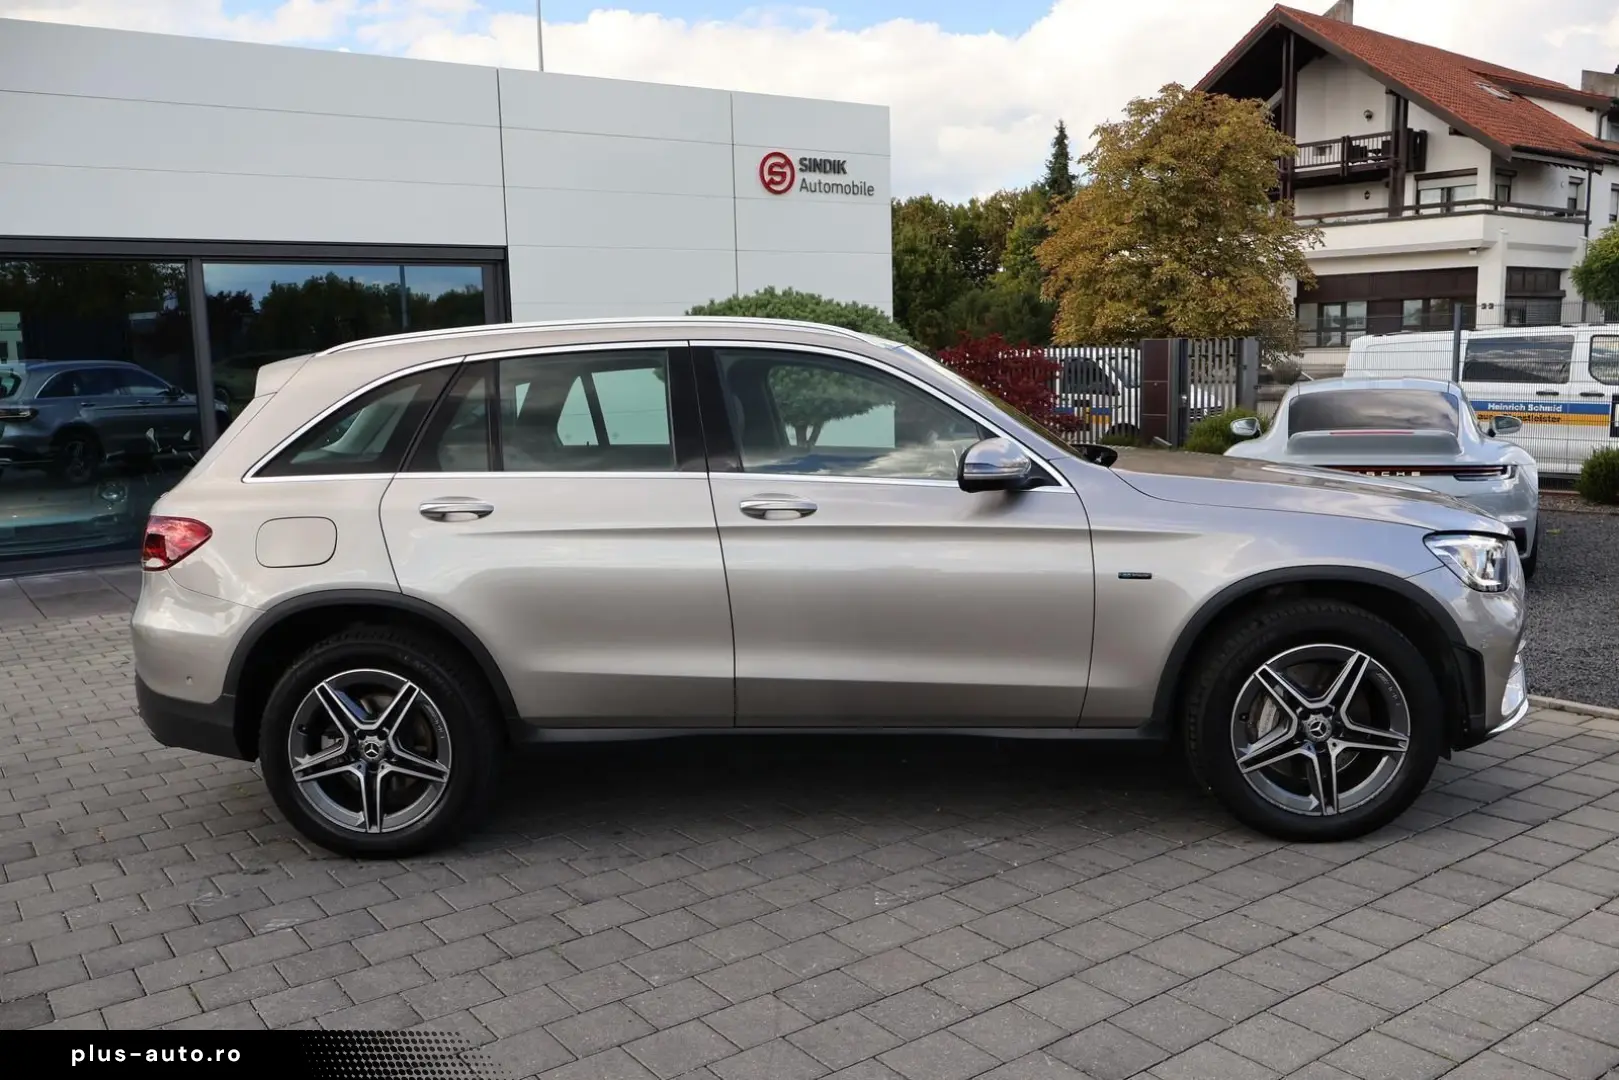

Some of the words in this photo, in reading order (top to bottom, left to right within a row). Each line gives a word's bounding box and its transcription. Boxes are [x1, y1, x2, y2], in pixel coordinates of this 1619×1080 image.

[799, 157, 848, 175] SINDIK
[799, 178, 875, 196] Automobile
[1488, 402, 1526, 412] Heinrich
[1528, 403, 1563, 413] Schmid
